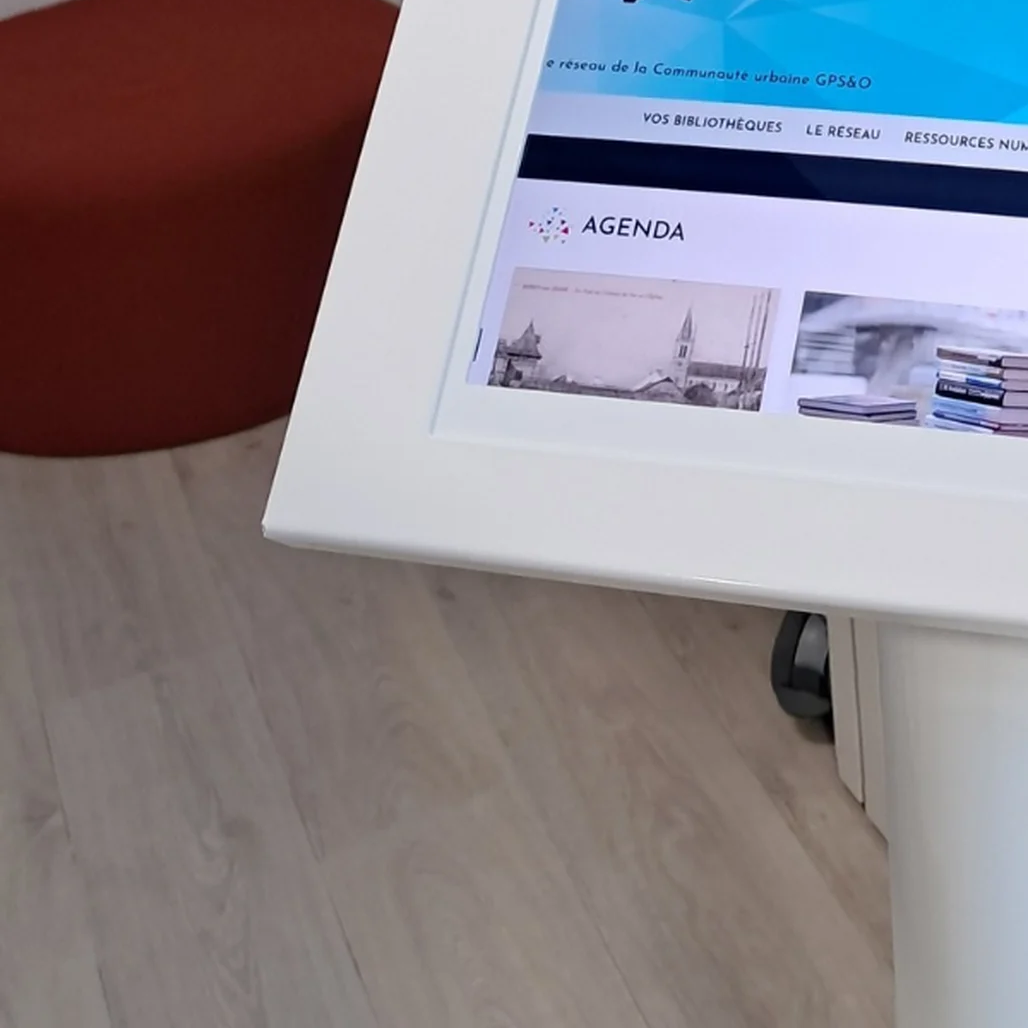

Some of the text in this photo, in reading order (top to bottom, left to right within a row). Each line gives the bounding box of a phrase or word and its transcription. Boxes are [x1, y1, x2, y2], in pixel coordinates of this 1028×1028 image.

[559, 57, 607, 72] réseau
[611, 59, 629, 73] de
[633, 60, 647, 75] la
[653, 62, 749, 82] Communauté
[754, 69, 810, 85] urbaine
[815, 72, 872, 90] GPS&O
[642, 112, 783, 134] VOS BIBLIOTHÈQUES
[805, 123, 882, 141] LE RÉSEAU
[903, 130, 995, 150] RESSOURCES
[581, 215, 685, 241] AGENDA
